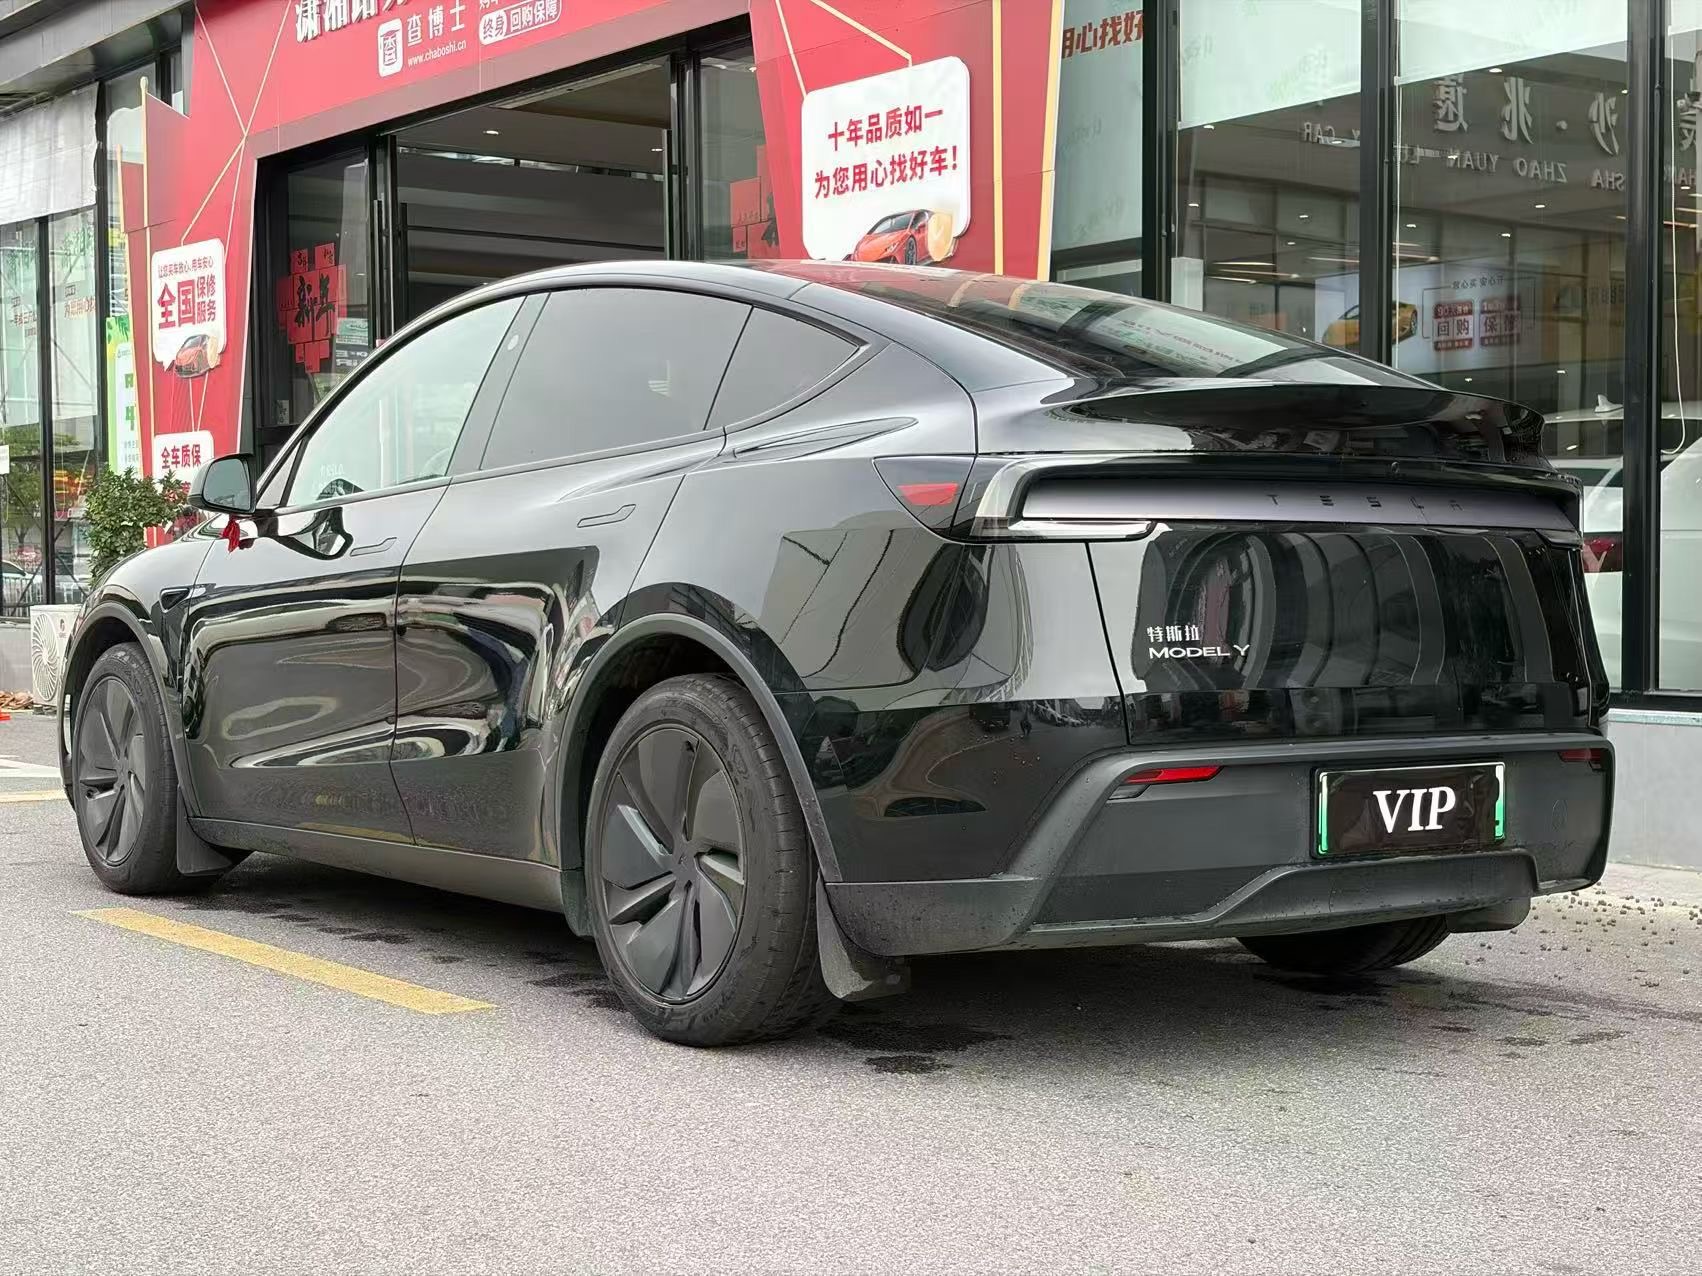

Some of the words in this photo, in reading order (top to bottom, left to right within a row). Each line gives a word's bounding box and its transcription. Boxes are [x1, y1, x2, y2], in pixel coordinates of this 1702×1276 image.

[406, 0, 466, 46] 查博士
[407, 40, 467, 67] www.chaboshi.cn
[827, 105, 944, 152] 十年品质如一
[196, 274, 216, 299] 保修
[157, 279, 196, 330] 全国
[196, 299, 217, 324] 服务
[1437, 318, 1470, 337] 回购
[160, 444, 202, 470] 全车质保
[1146, 624, 1200, 642] 特斯拉
[1148, 645, 1231, 659] MODEL
[1233, 643, 1251, 656] Y
[1372, 786, 1456, 834] VIP
